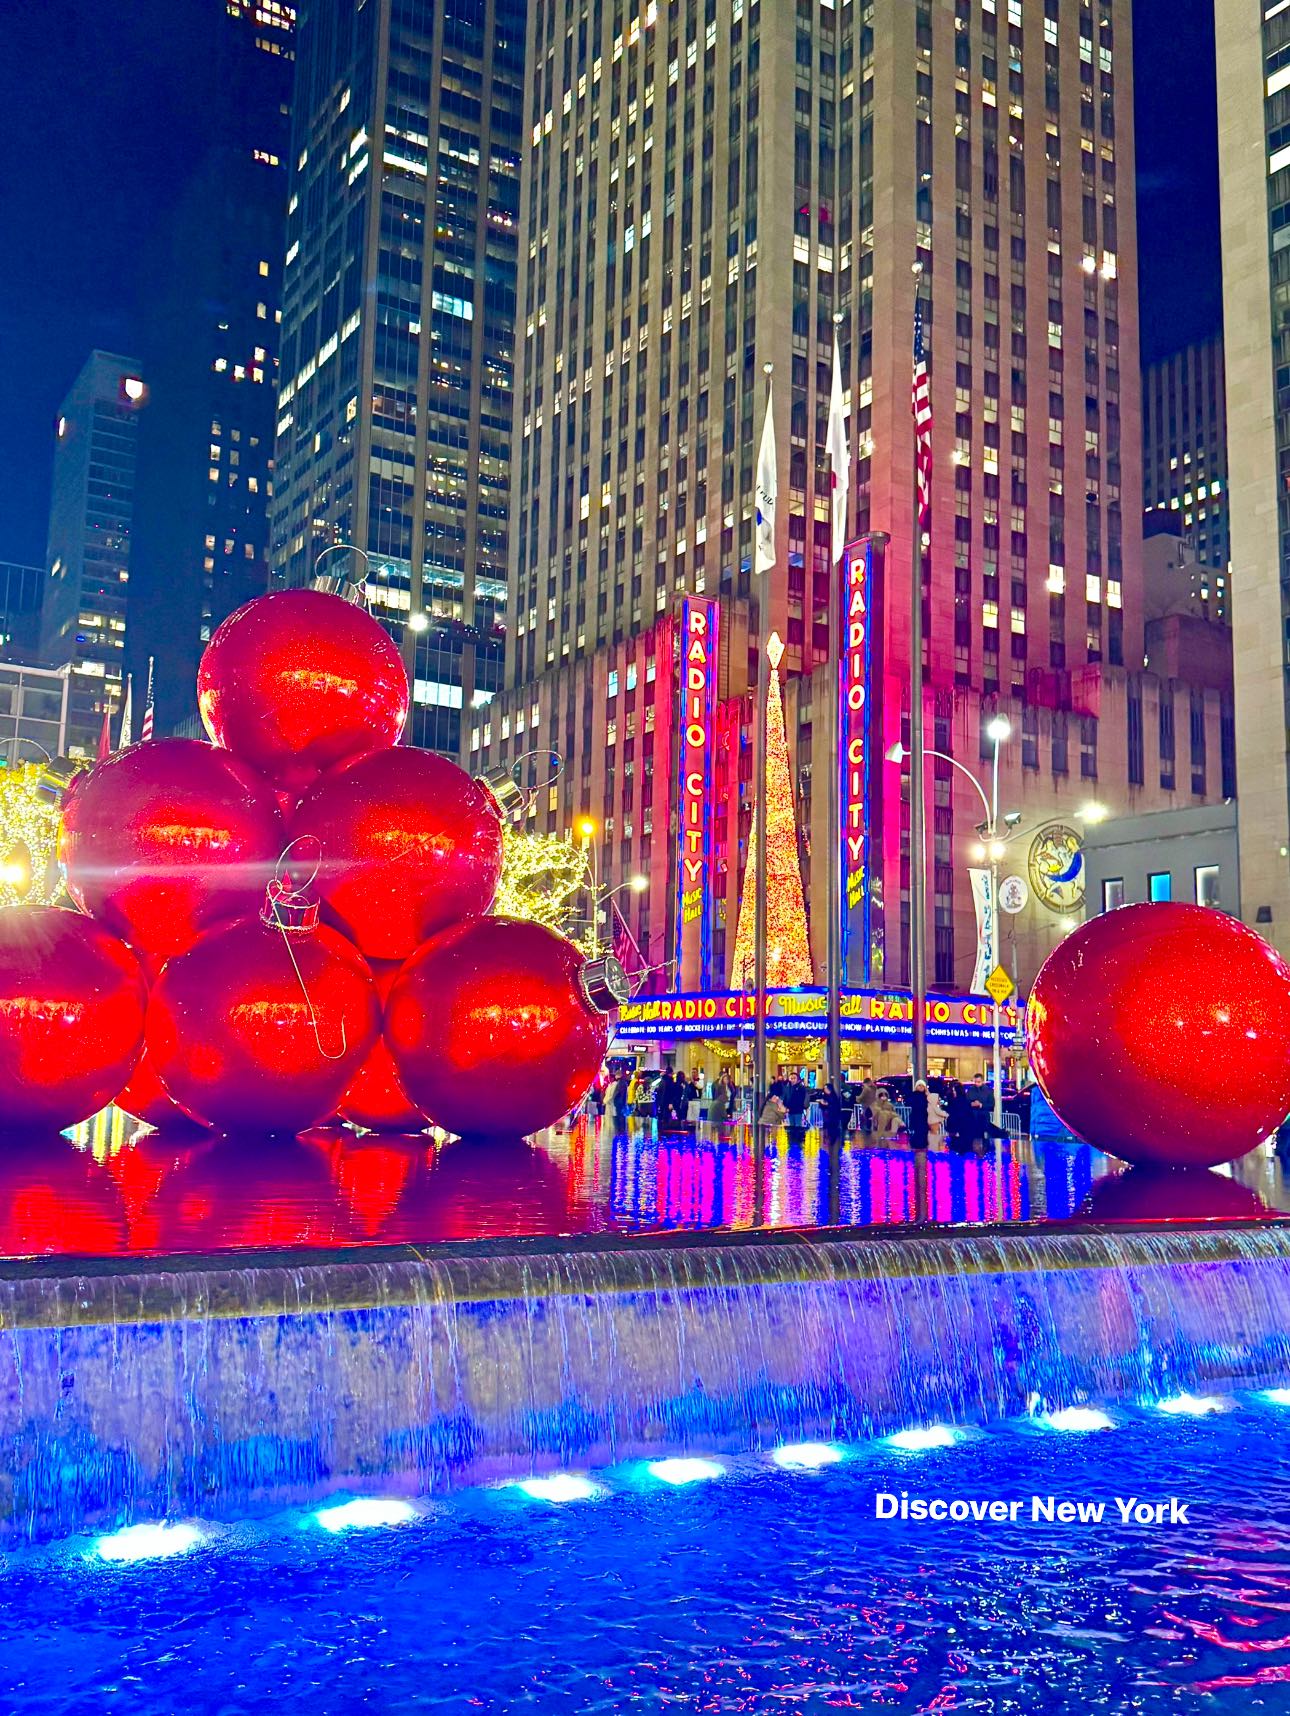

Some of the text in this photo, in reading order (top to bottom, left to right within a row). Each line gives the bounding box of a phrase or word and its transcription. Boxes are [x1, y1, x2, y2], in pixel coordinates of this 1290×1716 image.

[847, 558, 866, 861] RADIO CITY
[684, 610, 706, 881] RADIO CITY
[661, 998, 716, 1019] RADIO
[778, 995, 862, 1016] Music all
[845, 1023, 861, 1031] NOW
[865, 1024, 896, 1033] PLAYING
